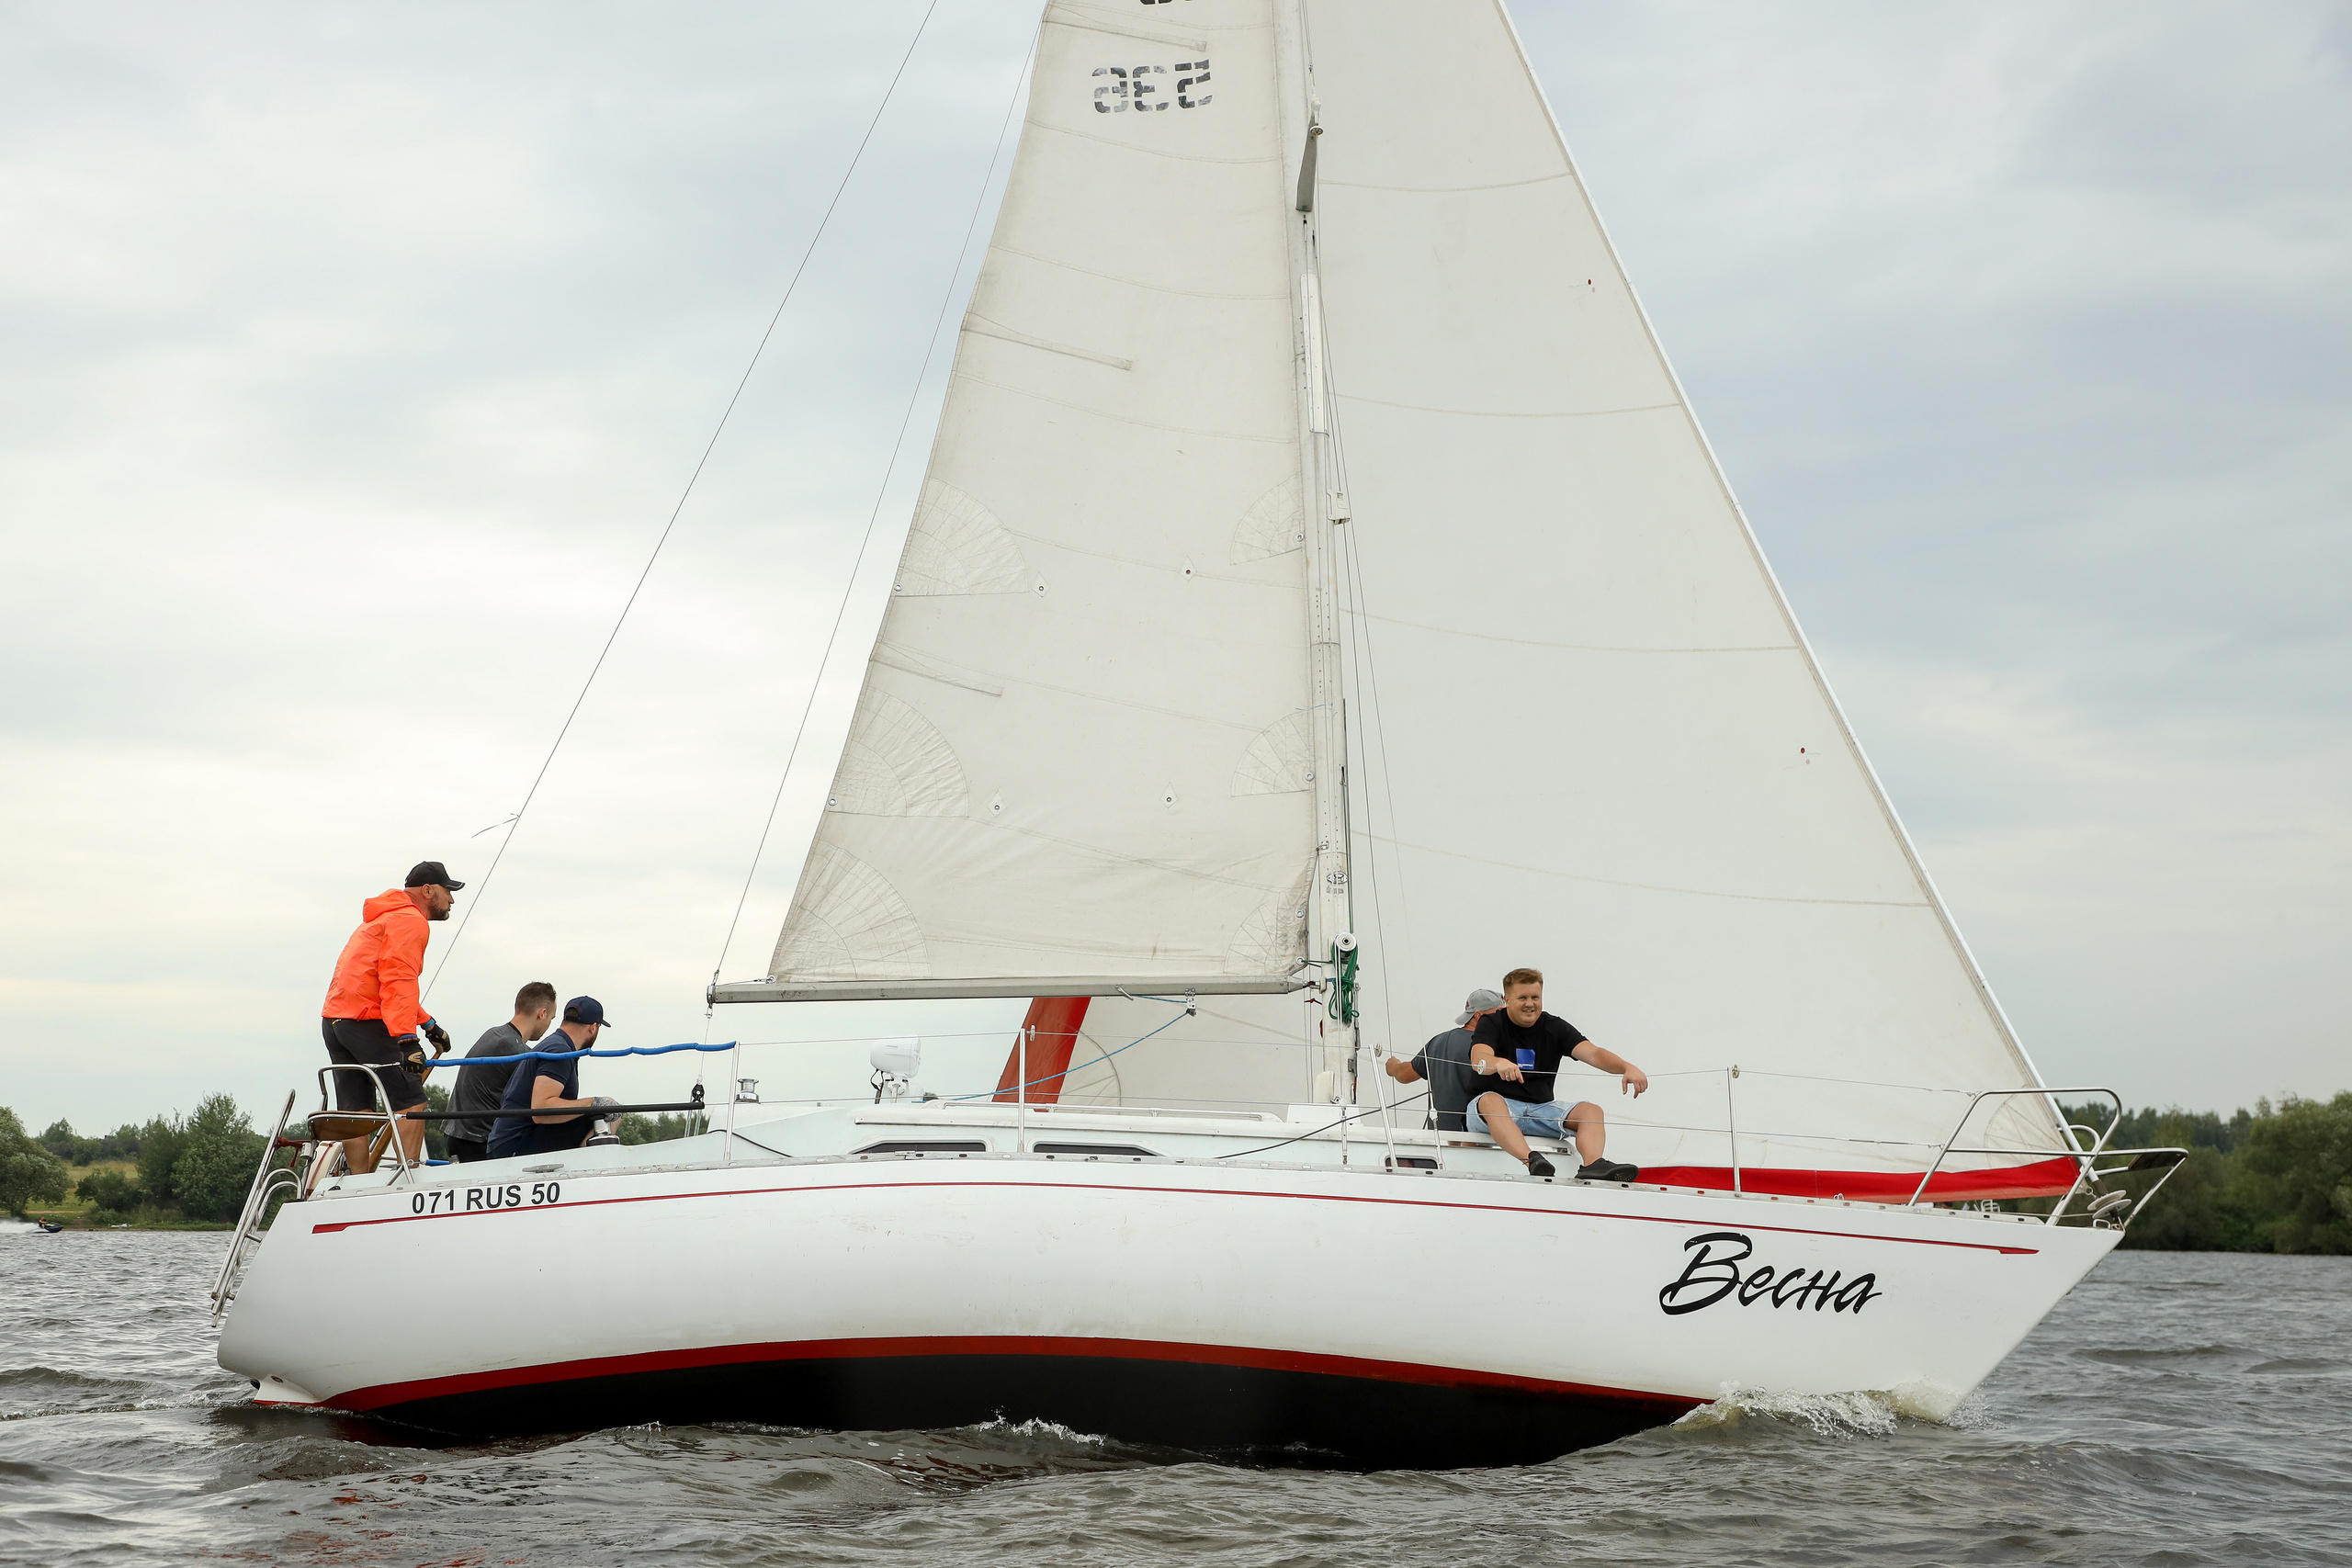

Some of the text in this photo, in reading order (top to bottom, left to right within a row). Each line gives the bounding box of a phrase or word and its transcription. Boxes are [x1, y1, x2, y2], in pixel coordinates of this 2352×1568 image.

[412, 1181, 560, 1214] 071 RUS 50
[1658, 1232, 1883, 1315] Весна
